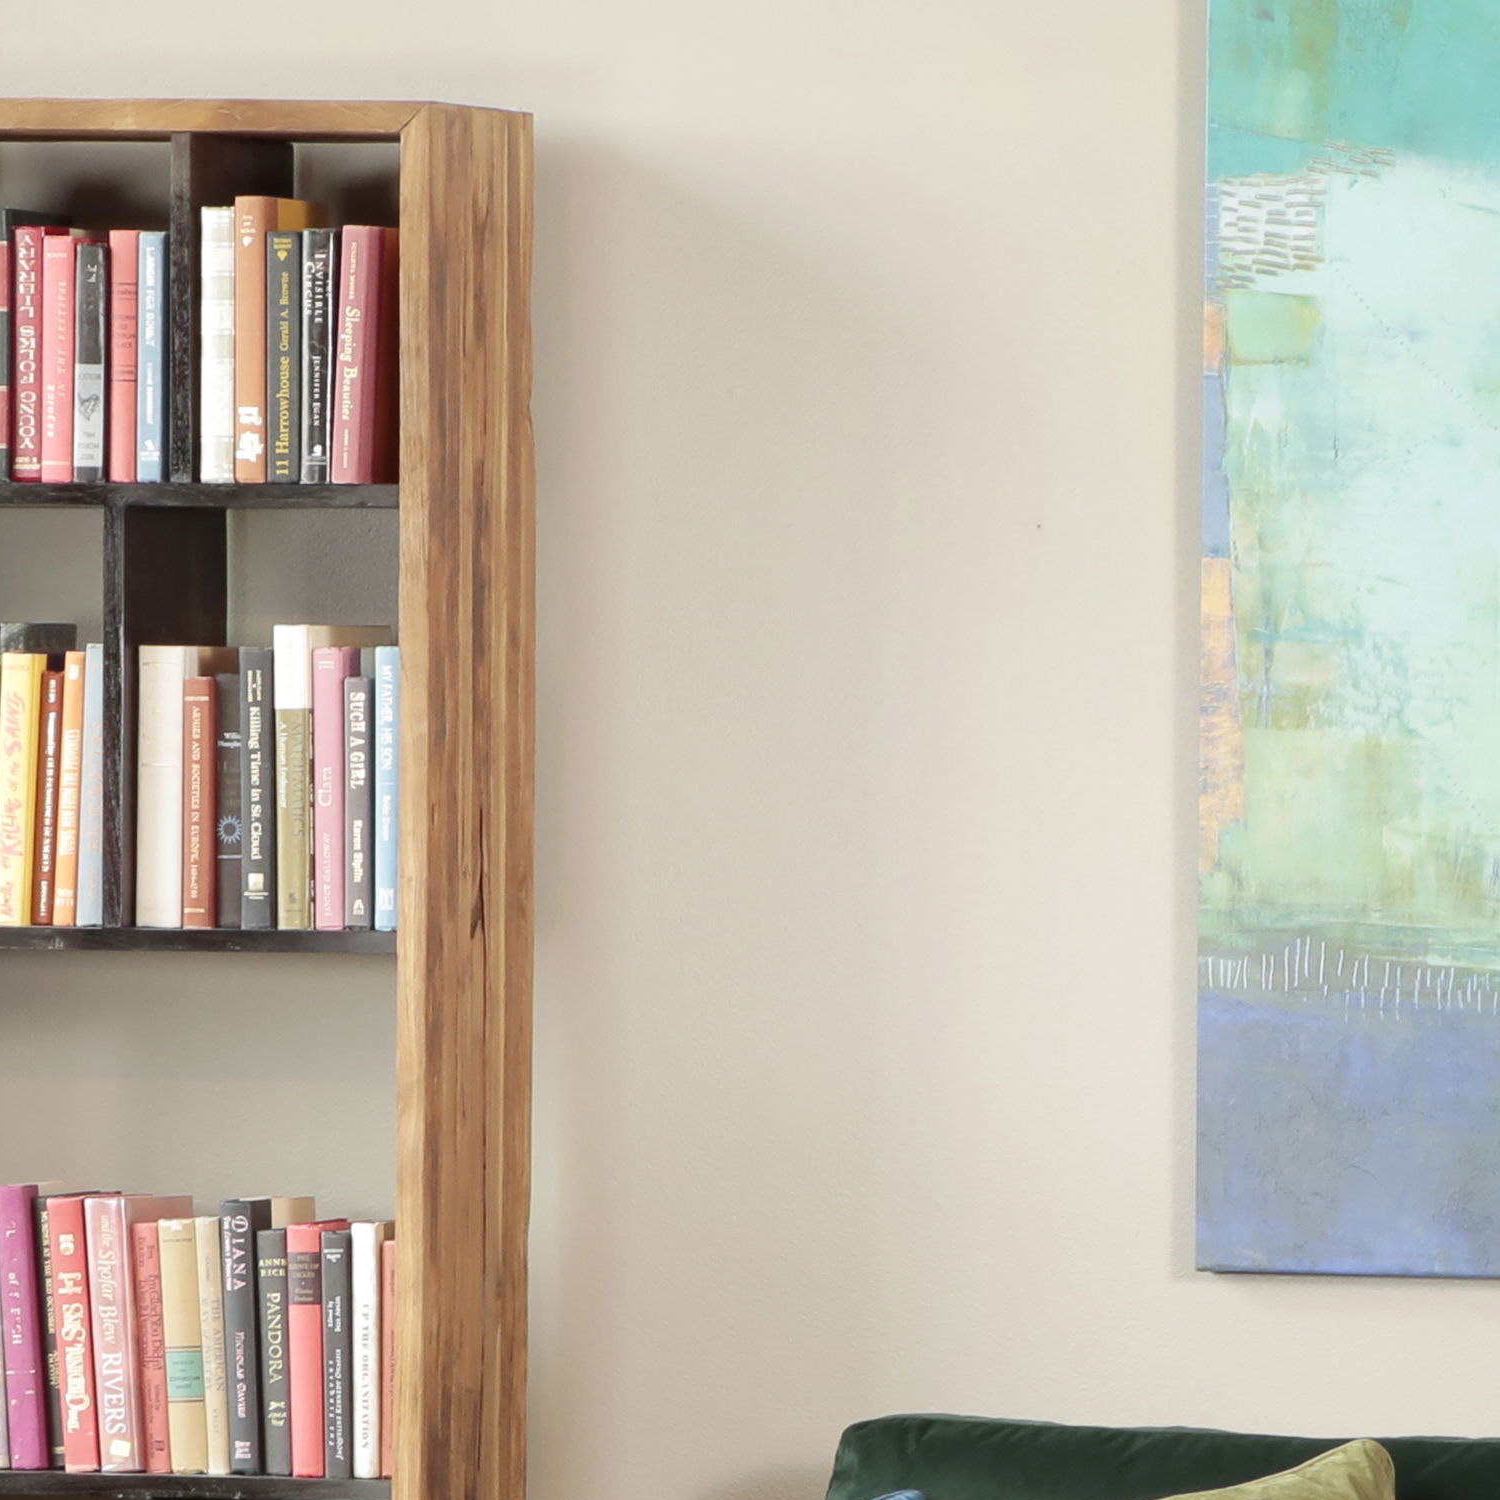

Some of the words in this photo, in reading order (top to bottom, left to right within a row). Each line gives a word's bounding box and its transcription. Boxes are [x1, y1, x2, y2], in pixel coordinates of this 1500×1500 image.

[19, 234, 36, 318] LIBRARY
[280, 272, 289, 305] Browne
[305, 261, 315, 315] CIRCUS
[313, 253, 325, 324] INVISIBLE
[145, 289, 156, 309] FOR
[279, 321, 289, 351] Gerald
[339, 305, 360, 362] Sleeping
[19, 326, 36, 384] FOLKS
[312, 355, 322, 400] JENNIFER
[341, 366, 360, 421] Beauties
[19, 391, 36, 449] YOUNG
[275, 356, 291, 454] Harrowhouse
[312, 402, 323, 427] EGAN
[276, 460, 289, 476] 11
[381, 665, 392, 682] MY
[350, 691, 365, 732] SUCH
[381, 684, 392, 725] FATHER,
[248, 706, 262, 749] Killing
[278, 721, 287, 730] A
[350, 736, 365, 747] A
[381, 727, 392, 745] HIS
[191, 741, 201, 761] AND
[278, 732, 287, 765] Human
[381, 747, 392, 770] SON
[191, 763, 201, 809] SOCIETIES
[250, 751, 262, 786] Time
[291, 720, 305, 838] MATHEMATICS
[318, 766, 333, 807] Clara
[350, 751, 365, 789] GIRL
[250, 788, 262, 801] in
[251, 804, 263, 821] St.
[191, 811, 200, 823] IN
[353, 819, 363, 850] Karen
[250, 822, 263, 859] Cloud
[322, 832, 332, 883] GALLOWAY
[352, 852, 363, 882] Siplin
[101, 1214, 112, 1232] and
[102, 1232, 113, 1247] the
[231, 1215, 249, 1291] DIANA
[258, 1257, 287, 1267] ANNE
[40, 1211, 49, 1245] MURDER
[46, 1295, 55, 1334] OCTOBER
[97, 1250, 117, 1300] Shofar
[259, 1268, 286, 1277] RICE
[60, 1303, 86, 1342] SINS
[99, 1305, 119, 1344] Blew
[212, 1297, 222, 1322] THE
[235, 1331, 245, 1379] NICHOLAS
[265, 1292, 284, 1384] PANDORA
[213, 1326, 225, 1392] AMERICAN
[100, 1352, 127, 1434] RIVERS
[236, 1381, 246, 1418] DAVIES
[335, 1416, 343, 1461] JACQUELINE
